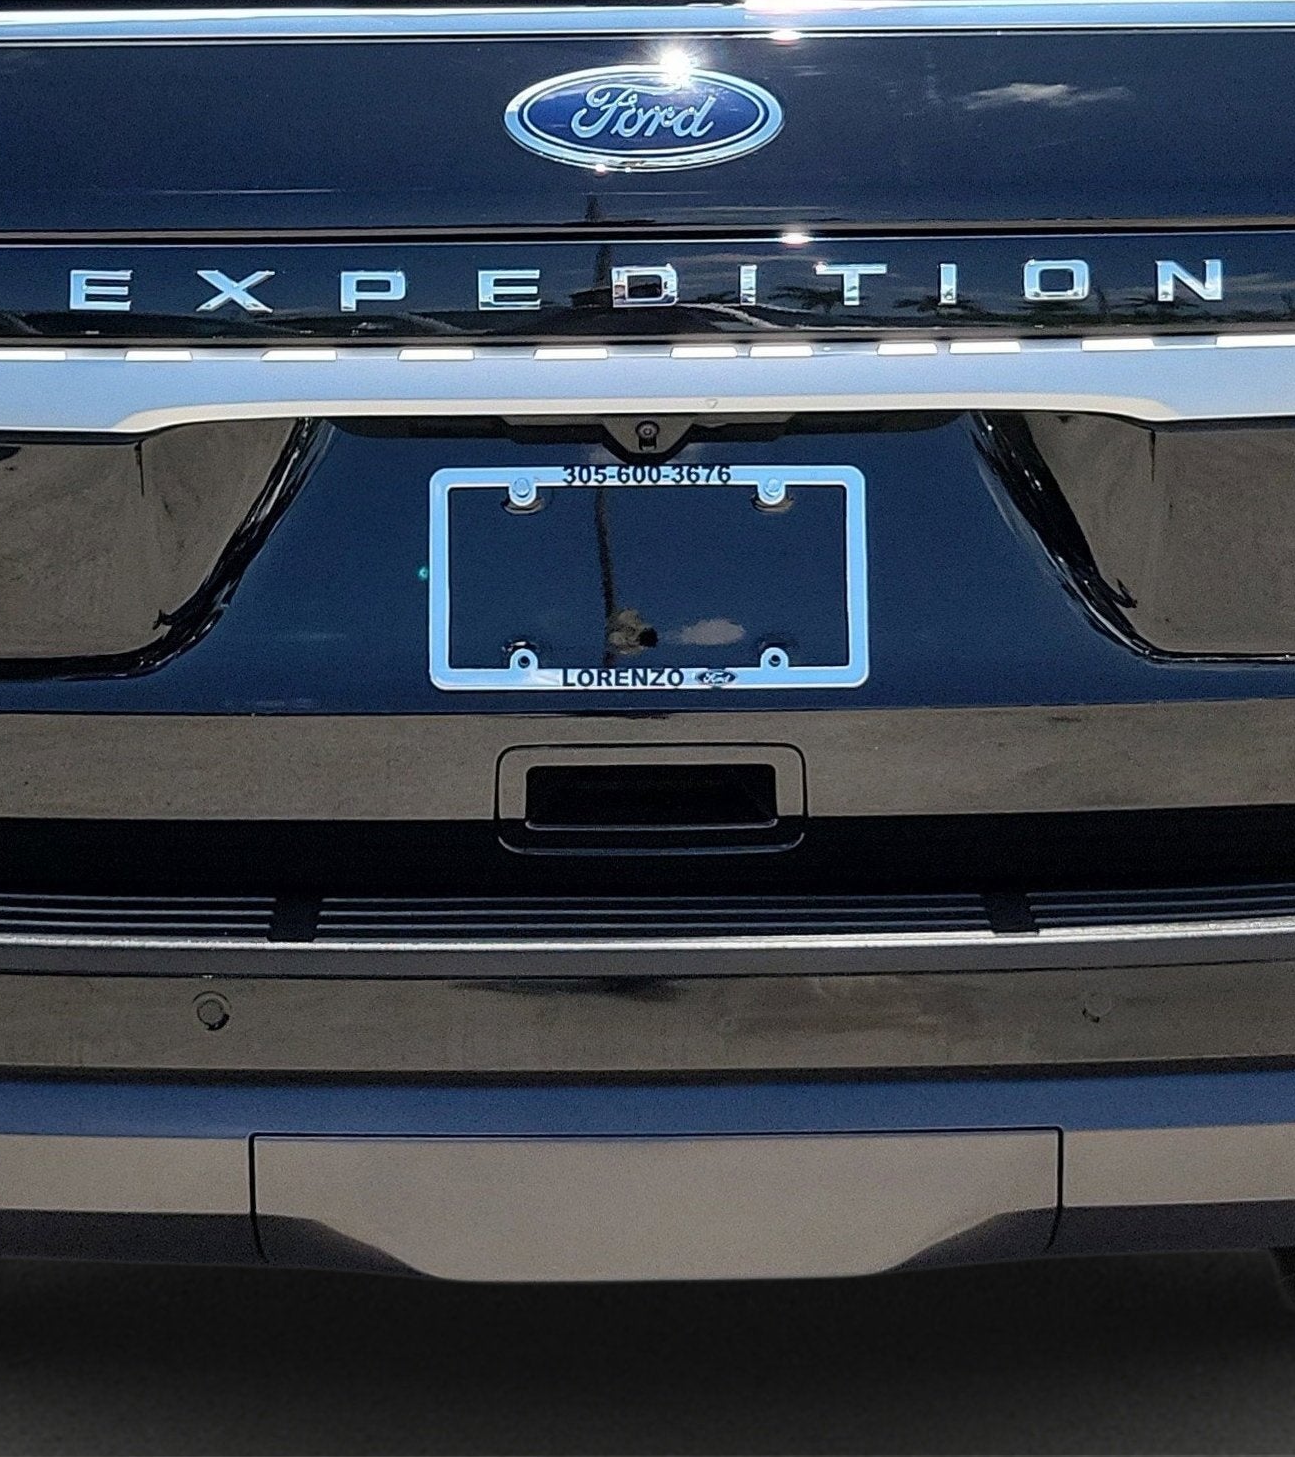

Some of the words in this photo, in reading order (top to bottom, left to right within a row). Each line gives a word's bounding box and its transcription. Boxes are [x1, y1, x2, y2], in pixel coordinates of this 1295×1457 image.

[571, 83, 715, 138] Ford
[68, 258, 1224, 313] EXPEDITION
[562, 465, 731, 485] 305-600-3676
[562, 668, 685, 688] LORENZO
